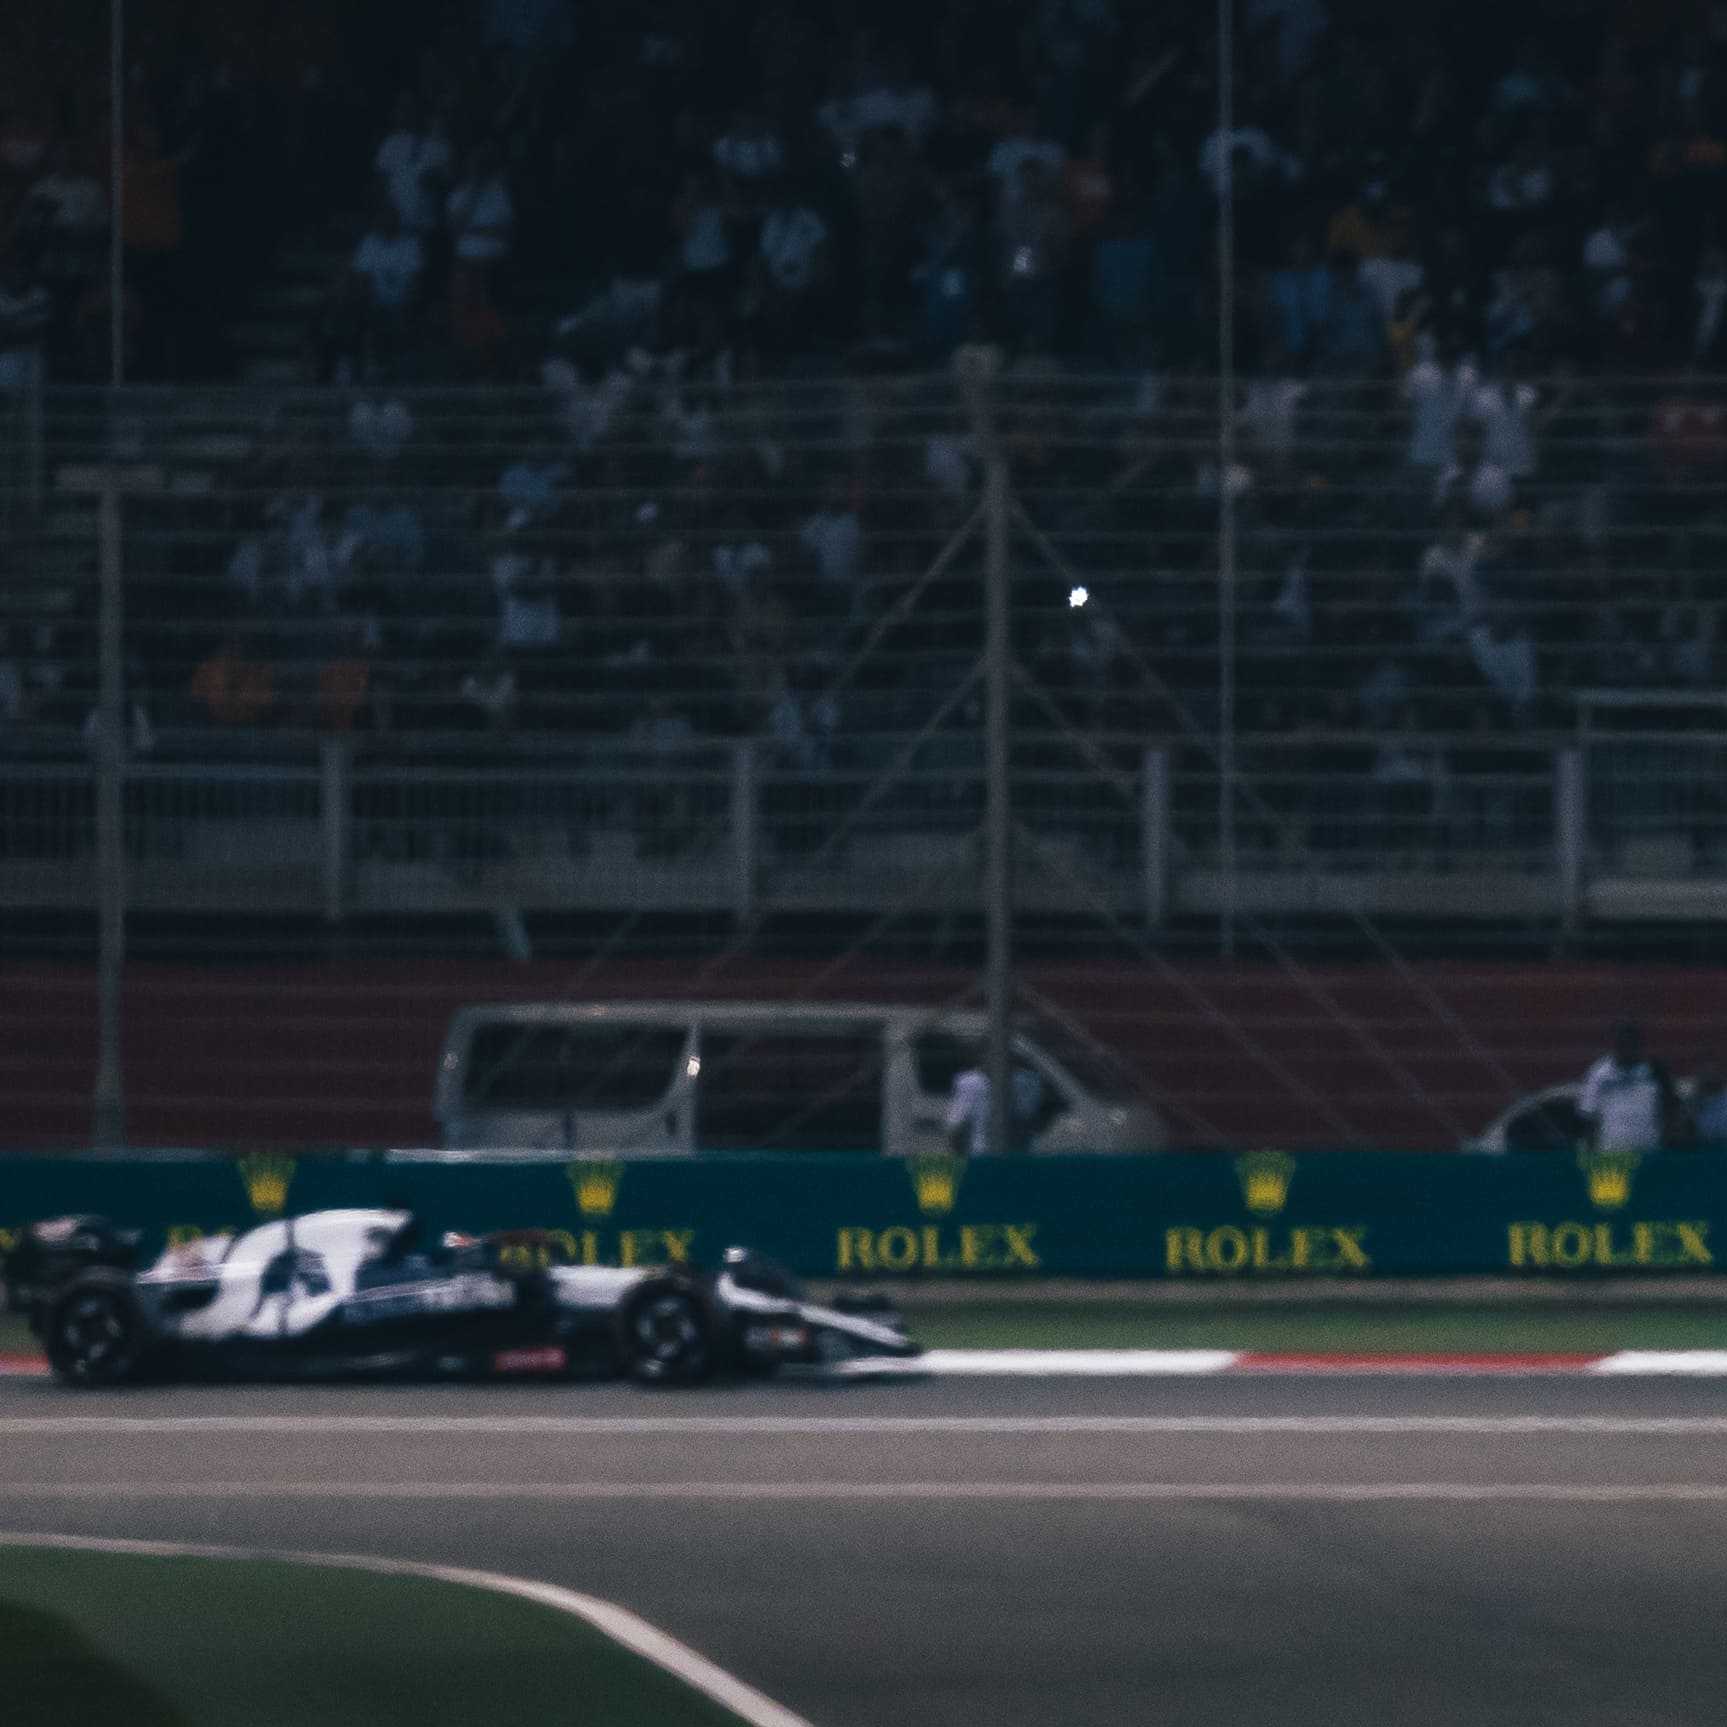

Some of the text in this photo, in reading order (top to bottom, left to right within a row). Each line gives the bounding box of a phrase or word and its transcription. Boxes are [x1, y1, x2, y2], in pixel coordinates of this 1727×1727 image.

[838, 1226, 1037, 1268] ROLEX
[1165, 1227, 1367, 1268] ROLEX
[1507, 1222, 1711, 1265] ROLEX
